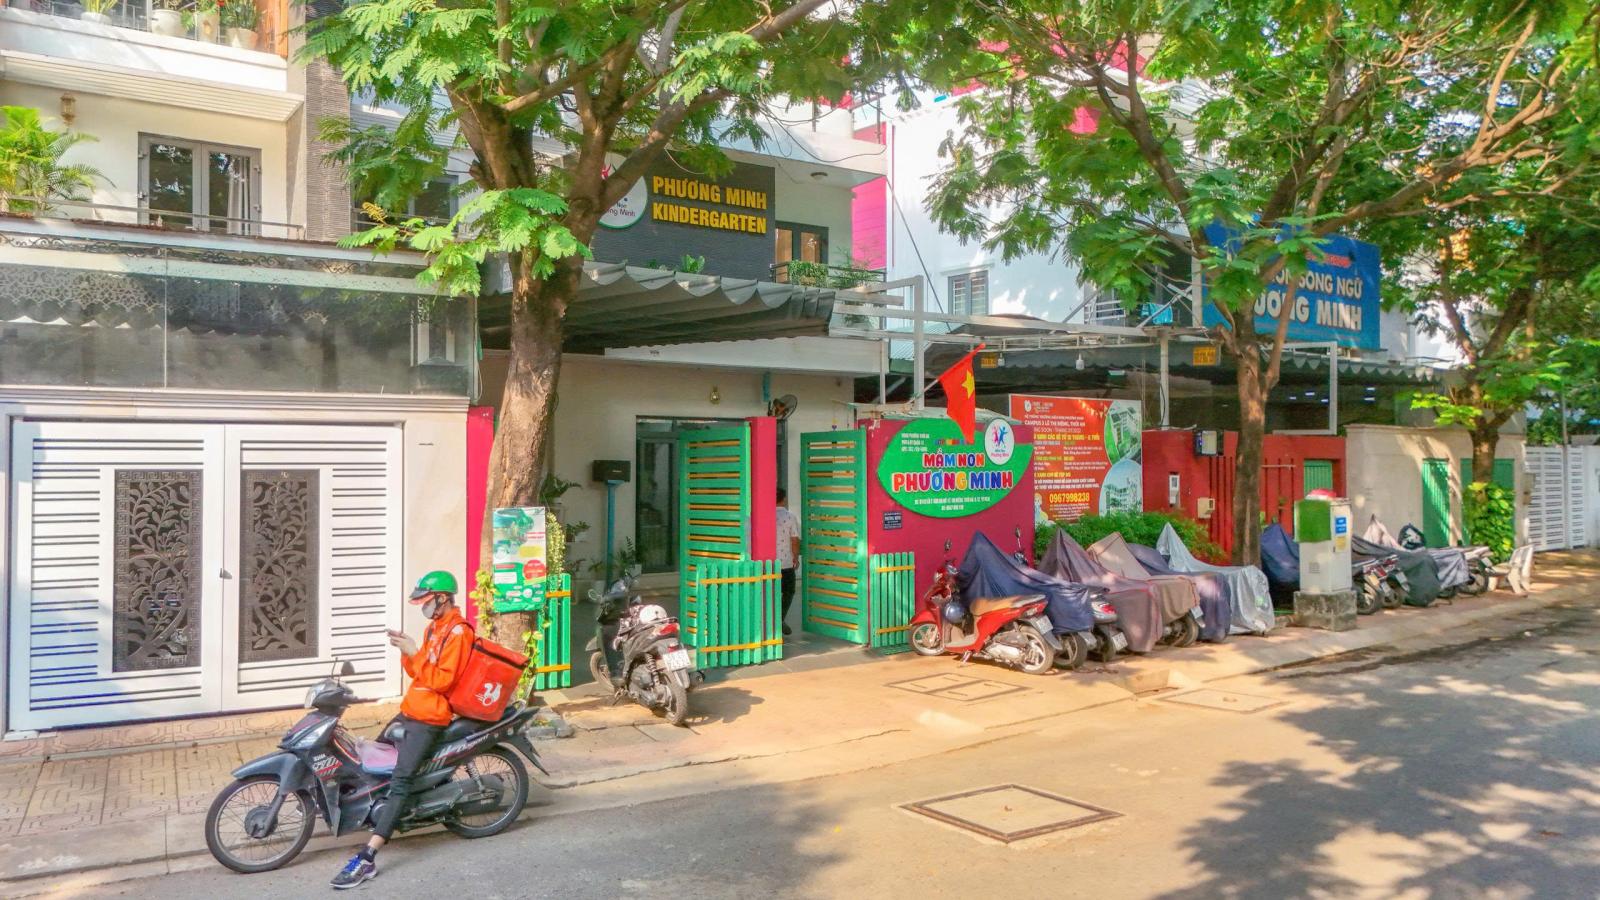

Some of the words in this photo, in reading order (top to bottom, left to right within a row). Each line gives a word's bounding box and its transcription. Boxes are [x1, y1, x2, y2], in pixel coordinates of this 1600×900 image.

[653, 176, 721, 203] PHƯƠNG
[725, 187, 767, 209] MINH
[653, 202, 767, 234] KINDERGARTEN
[1316, 300, 1362, 331] MINH
[957, 452, 985, 468] NON
[891, 469, 967, 493] PHƯƠNG
[969, 471, 1013, 490] MINH
